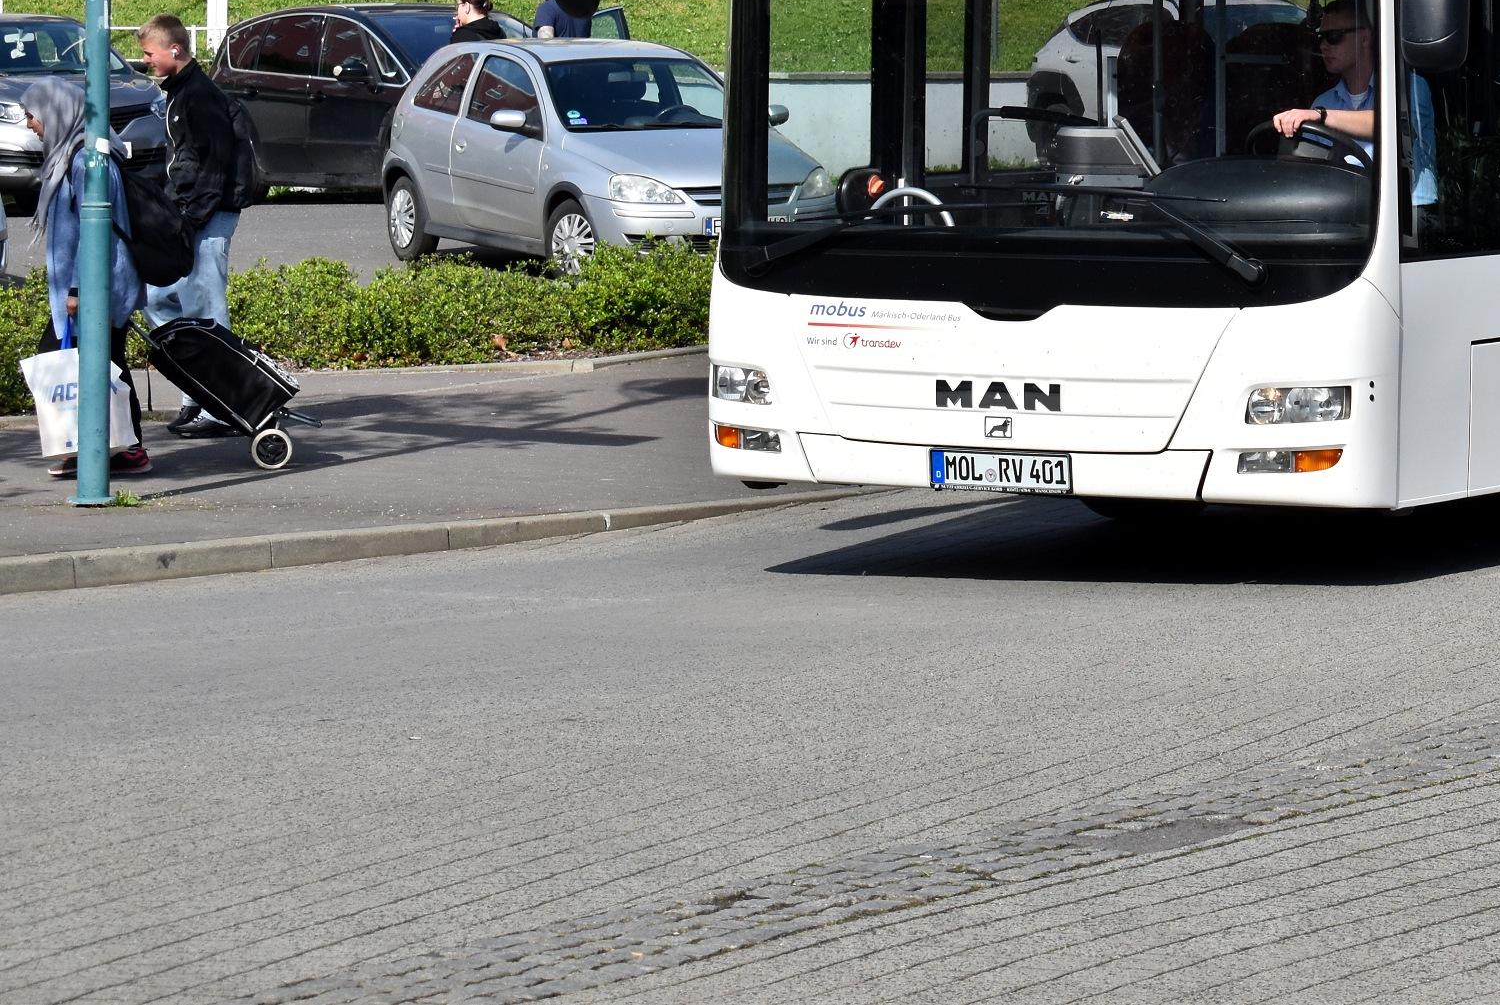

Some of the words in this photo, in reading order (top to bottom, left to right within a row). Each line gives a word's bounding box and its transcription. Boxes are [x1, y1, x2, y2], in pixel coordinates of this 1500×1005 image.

[809, 301, 867, 318] mobus
[871, 310, 946, 322] Märkisch-Oderland
[806, 336, 820, 346] Wir
[821, 336, 838, 347] sind
[861, 339, 902, 349] transdev
[935, 380, 1061, 412] MAN
[945, 455, 983, 481] MOL
[998, 457, 1023, 484] RV
[1029, 459, 1067, 485] 401
